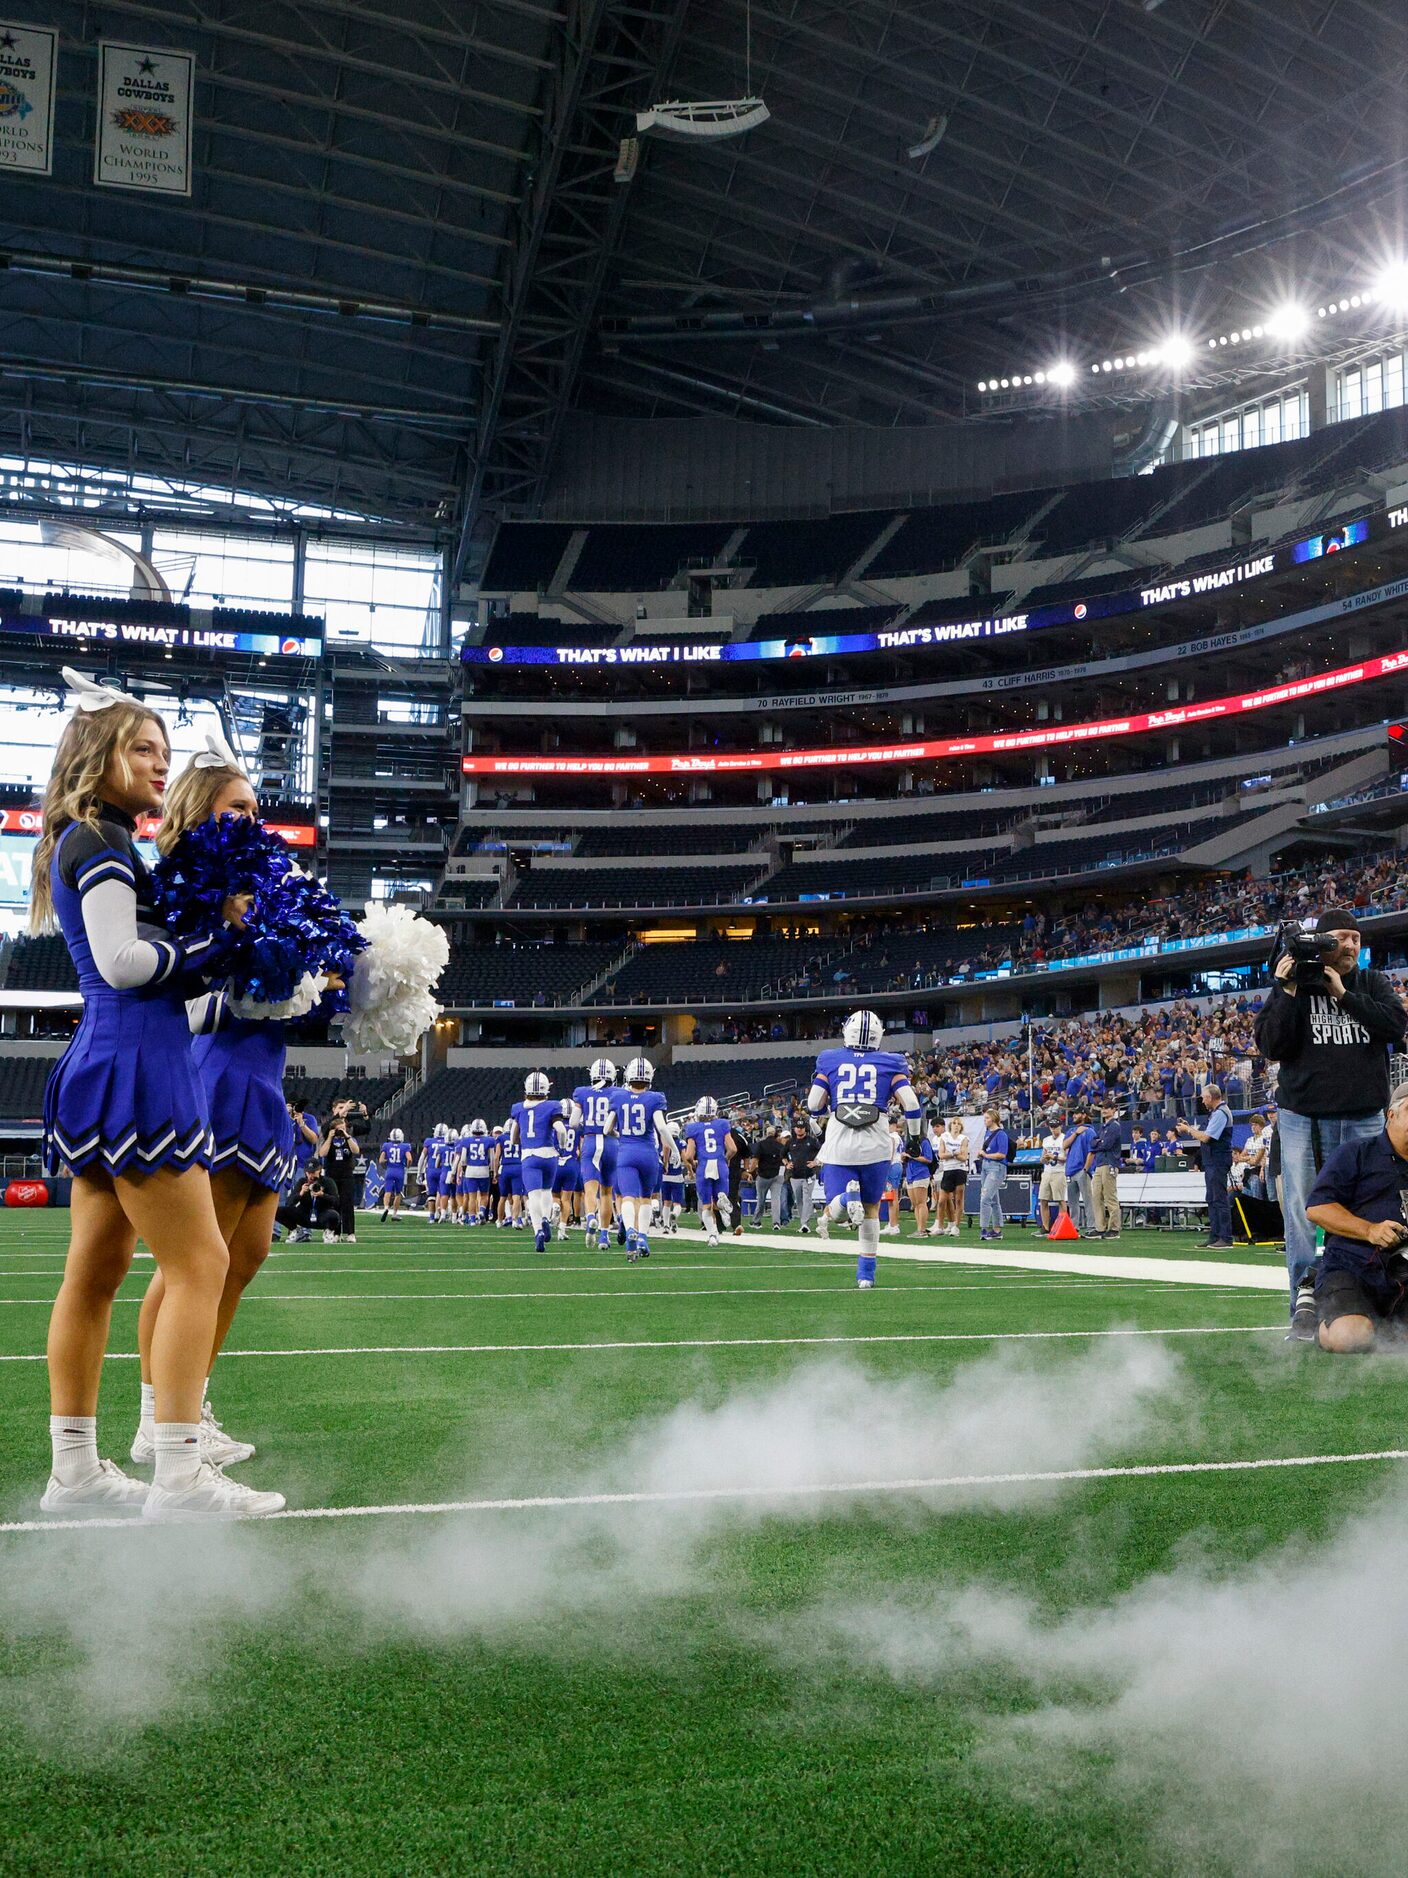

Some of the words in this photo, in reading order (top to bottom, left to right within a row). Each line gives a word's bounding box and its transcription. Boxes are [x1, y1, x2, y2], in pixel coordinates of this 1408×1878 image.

[0, 55, 31, 67] LLAS
[123, 76, 170, 92] DALLAS
[117, 87, 175, 103] COWBOYS
[120, 144, 169, 160] WORLD
[104, 155, 183, 174] CHAMPIONS
[130, 172, 158, 184] 1995
[1141, 580, 1191, 605] THAT'S
[1193, 569, 1236, 593] WHAT
[1237, 566, 1242, 581] I
[1245, 556, 1274, 579] LIKE
[1342, 601, 1352, 610] 54
[1355, 590, 1382, 607] RANDY
[49, 618, 118, 639] THAT'S
[120, 625, 179, 644] WHAT
[182, 629, 189, 644] I
[193, 631, 237, 649] LIKE
[878, 628, 932, 648] THAT'S
[934, 621, 982, 642] WHAT
[985, 620, 991, 635] I
[994, 615, 1028, 634] LIKE
[1177, 646, 1187, 655] 22
[1190, 641, 1209, 652] BOB
[1210, 634, 1238, 648] HAYES
[556, 647, 617, 664] THAT'S
[620, 646, 667, 662] WHAT
[673, 647, 679, 660] I
[683, 645, 721, 660] LIKE
[982, 680, 993, 688] 43
[997, 676, 1022, 687] CLIFF
[1024, 670, 1056, 683] HARRIS
[758, 700, 768, 708] 70
[771, 697, 816, 707] RAYFIELD
[818, 694, 856, 704] WRIGHT
[1310, 995, 1346, 1014] INS
[1310, 1014, 1333, 1024] HIGH
[1312, 1023, 1371, 1045] SPORTS
[837, 1063, 877, 1104] 23
[585, 1096, 609, 1127] 18
[621, 1103, 646, 1136] 13
[526, 1109, 535, 1138] 1
[704, 1128, 717, 1153] 6
[389, 1147, 401, 1164] 31
[469, 1143, 485, 1160] 54
